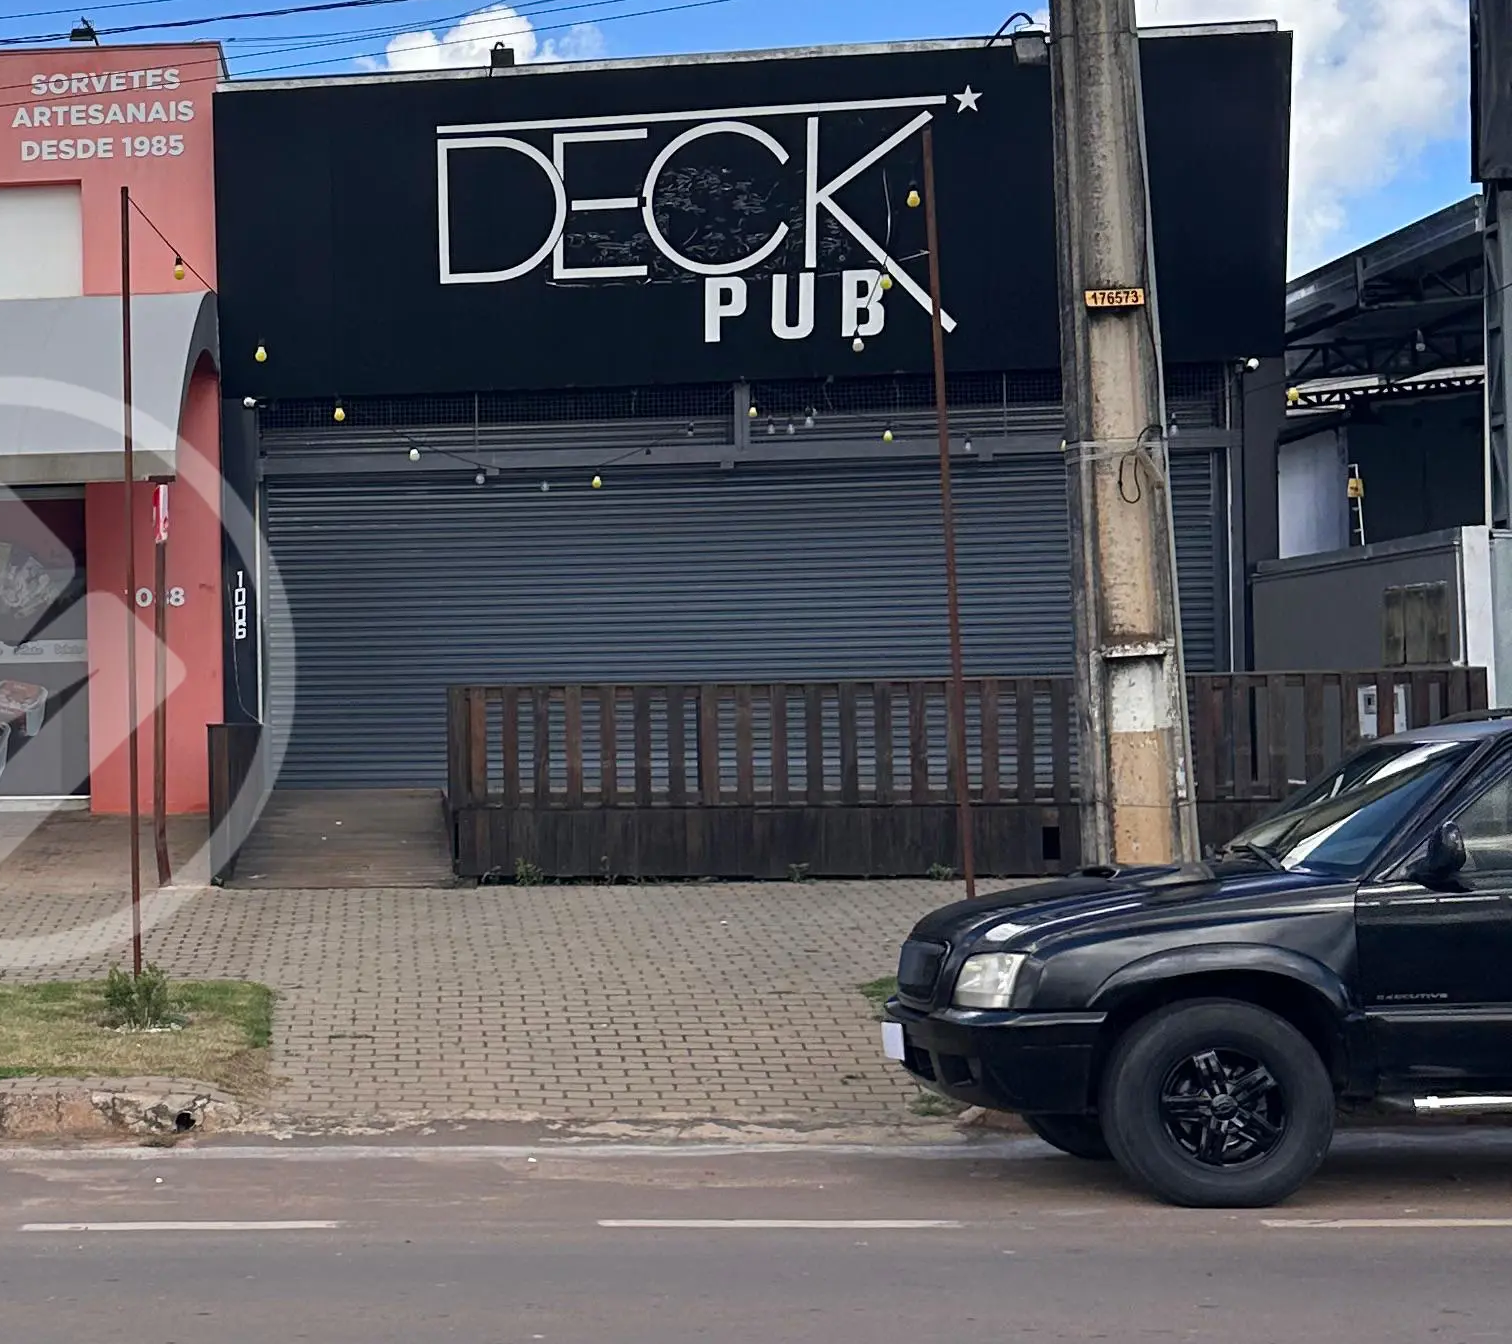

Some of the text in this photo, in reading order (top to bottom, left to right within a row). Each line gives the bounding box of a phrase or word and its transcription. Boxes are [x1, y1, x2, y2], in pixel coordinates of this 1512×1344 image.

[30, 68, 181, 97] SORVETES
[11, 100, 195, 129] ARTESANAIS
[21, 134, 186, 162] DESDE 1985
[436, 109, 958, 334] DECK
[703, 269, 887, 344] PUB
[1090, 290, 1139, 306] 176573
[124, 587, 185, 608] 08
[234, 570, 247, 640] 1006
